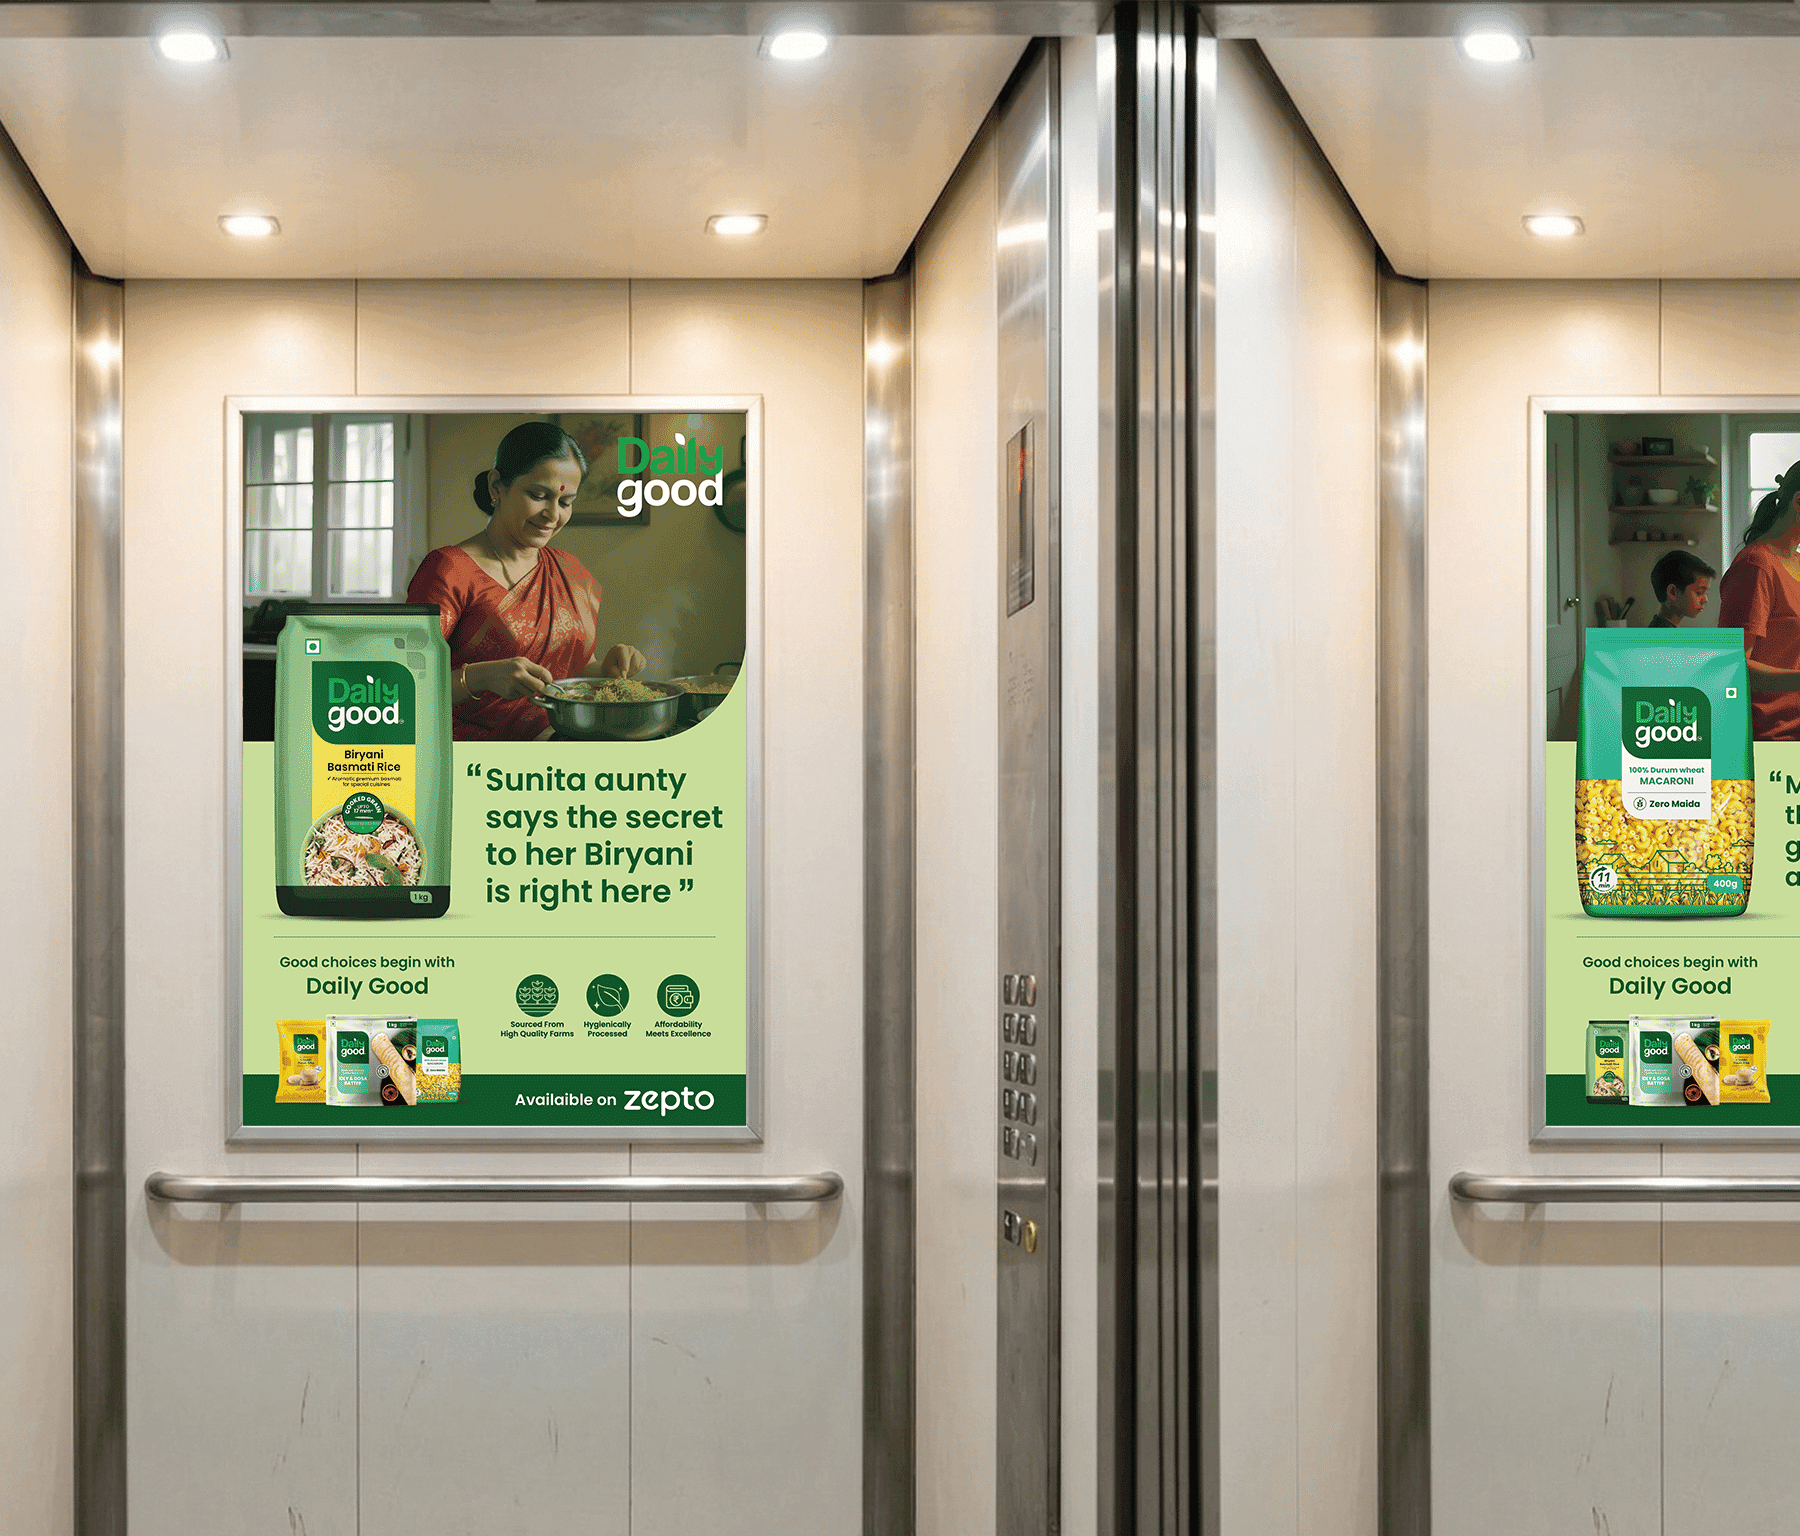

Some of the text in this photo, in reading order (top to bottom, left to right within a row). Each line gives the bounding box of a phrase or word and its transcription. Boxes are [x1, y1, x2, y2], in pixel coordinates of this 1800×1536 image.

[618, 433, 723, 477] Daily
[617, 468, 723, 518] good
[328, 675, 399, 704] Daily
[328, 699, 399, 732] good
[1635, 699, 1698, 724] Daily
[1635, 720, 1698, 748] good
[344, 749, 384, 761] Biryani
[327, 762, 401, 772] Basmati Rice
[595, 768, 687, 799] aunty
[1639, 777, 1694, 785] MACARONI
[345, 796, 366, 814] COOKED
[366, 797, 382, 814] GRAIN
[1649, 799, 1701, 808] Zero Maida
[486, 804, 723, 837] says the secret
[486, 839, 693, 871] to her Biryani
[1597, 872, 1611, 883] 11
[1713, 880, 1738, 890] 400g
[419, 894, 429, 903] kg
[487, 877, 510, 903] is
[519, 877, 593, 909] right
[280, 955, 455, 972] Good choices begin with
[1583, 955, 1758, 972] Good choices begin with
[306, 976, 429, 1001] Daily Good
[1609, 976, 1732, 1001] Daily Good
[510, 1020, 565, 1029] Sourced From
[583, 1020, 632, 1030] Hygienically
[654, 1020, 703, 1030] Affordability
[500, 1030, 575, 1040] High Quality Farms
[587, 1030, 628, 1038] Processed
[645, 1030, 712, 1038] Meets Excellence
[341, 1038, 365, 1048] Daily
[1644, 1038, 1668, 1048] Daily
[341, 1047, 365, 1058] good
[1600, 1047, 1620, 1055] good
[1644, 1047, 1668, 1058] good
[596, 1095, 617, 1106] on
[623, 1086, 715, 1117] zepto
